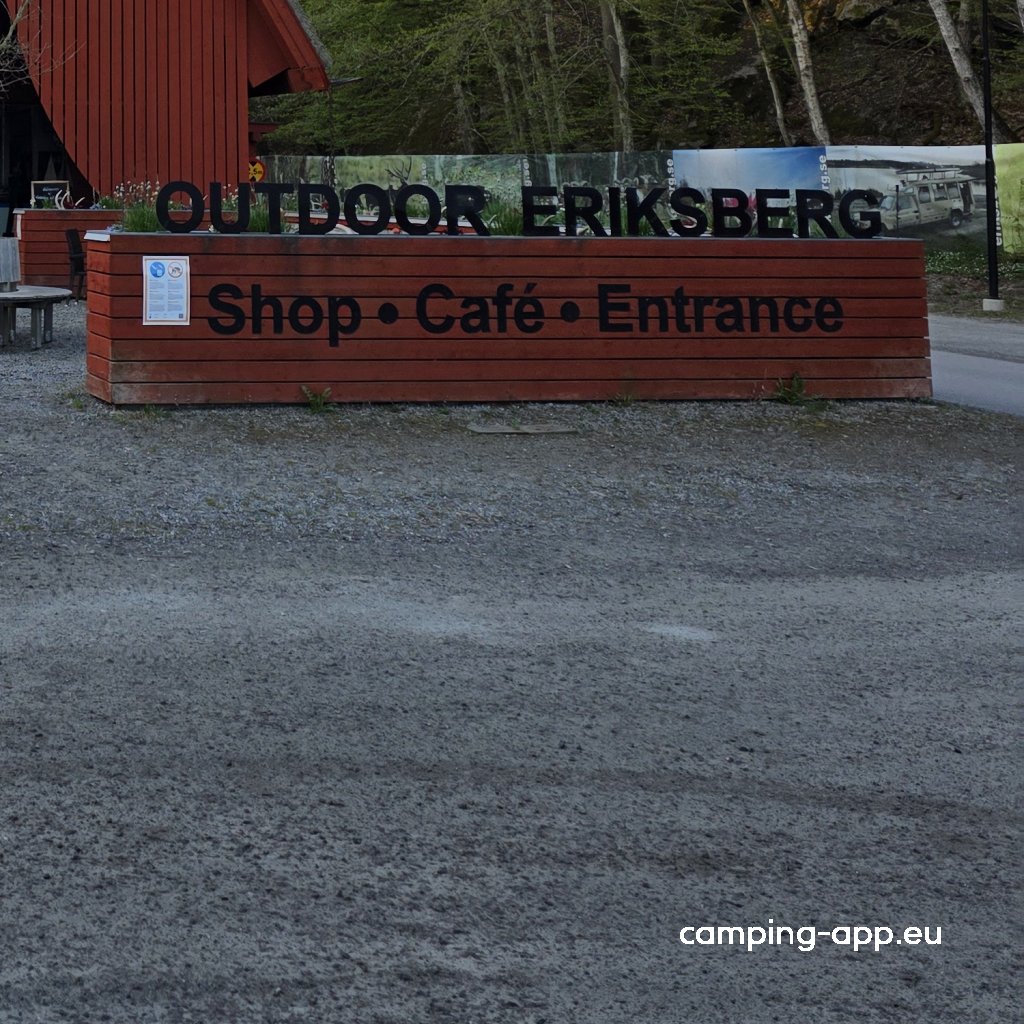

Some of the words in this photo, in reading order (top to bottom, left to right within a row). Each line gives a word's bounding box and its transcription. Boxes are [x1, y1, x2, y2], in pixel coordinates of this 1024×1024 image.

[155, 181, 490, 236] OUTDOOR
[521, 186, 882, 239] ERIKSBERG
[207, 283, 362, 348] Shop
[416, 283, 545, 334] Café
[597, 283, 845, 333] Entrance
